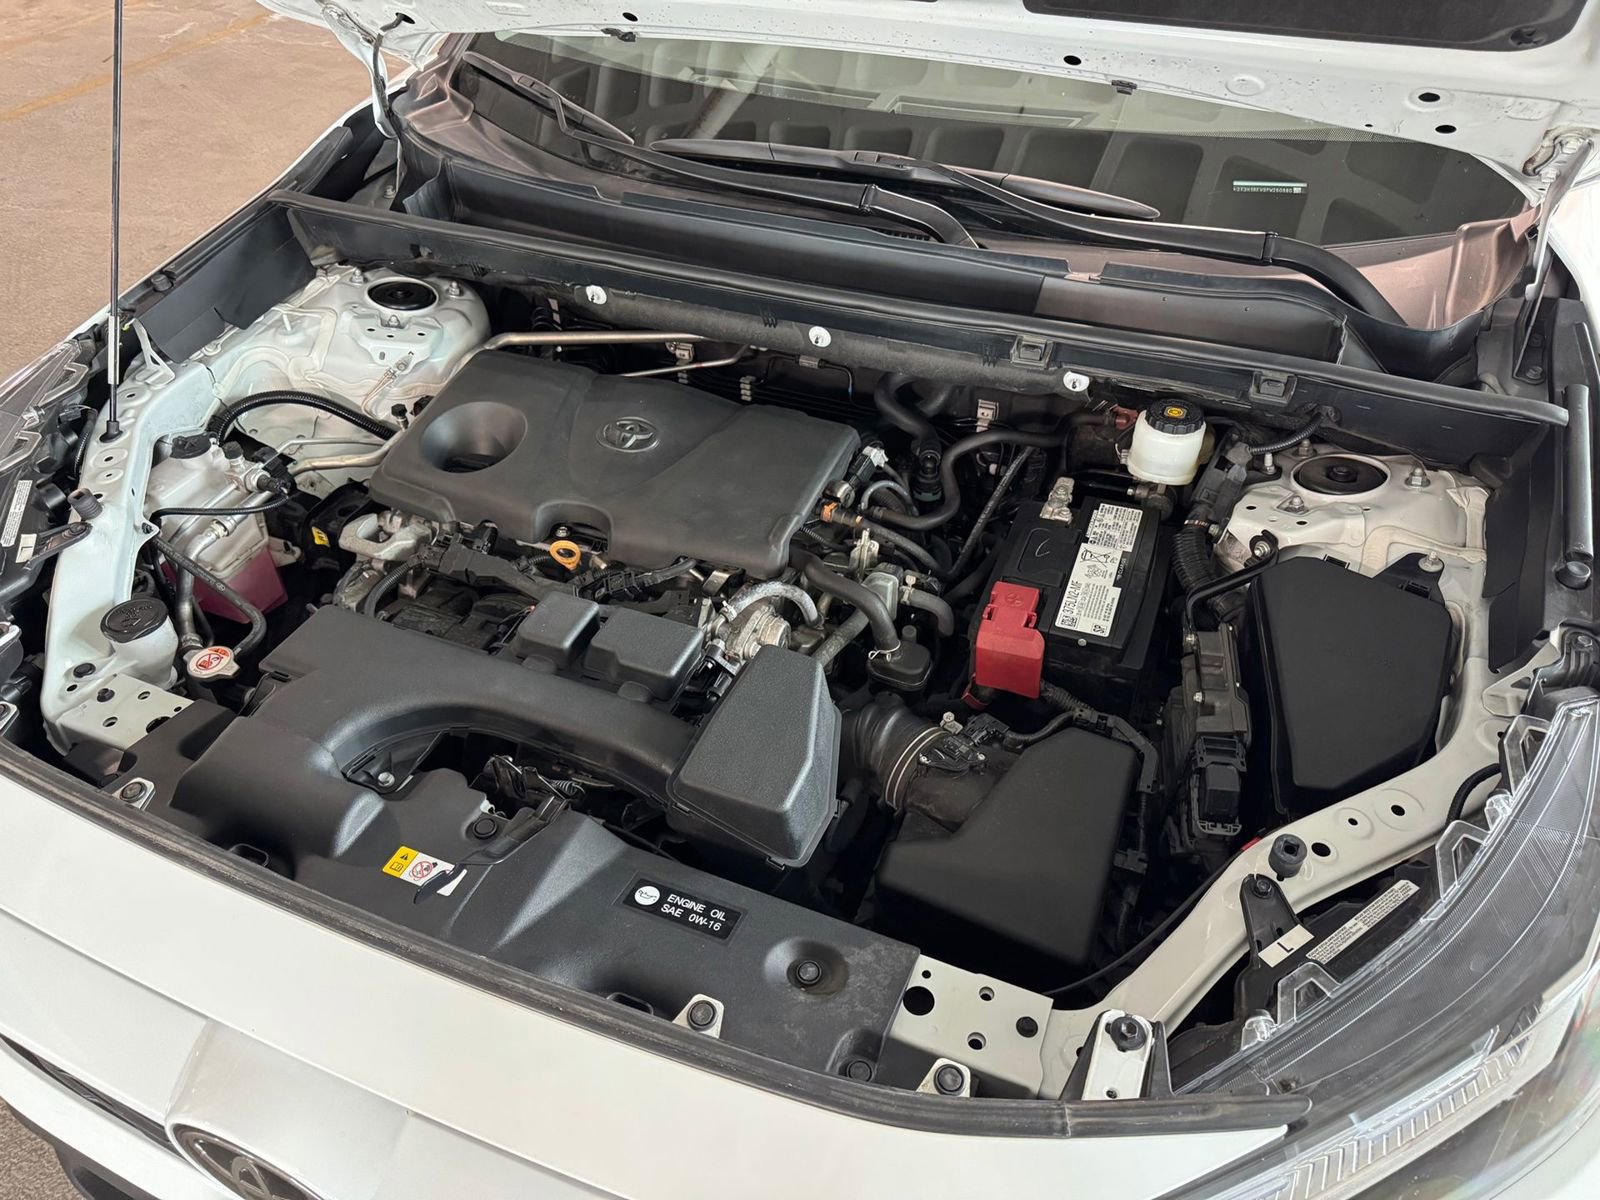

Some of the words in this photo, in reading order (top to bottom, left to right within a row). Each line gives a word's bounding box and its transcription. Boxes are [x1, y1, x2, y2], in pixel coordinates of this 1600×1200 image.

[661, 904, 684, 917] SAE
[689, 914, 722, 931] 0W-16
[667, 894, 706, 913] ENGINE
[710, 909, 726, 921] OIL
[1276, 942, 1294, 953] L
